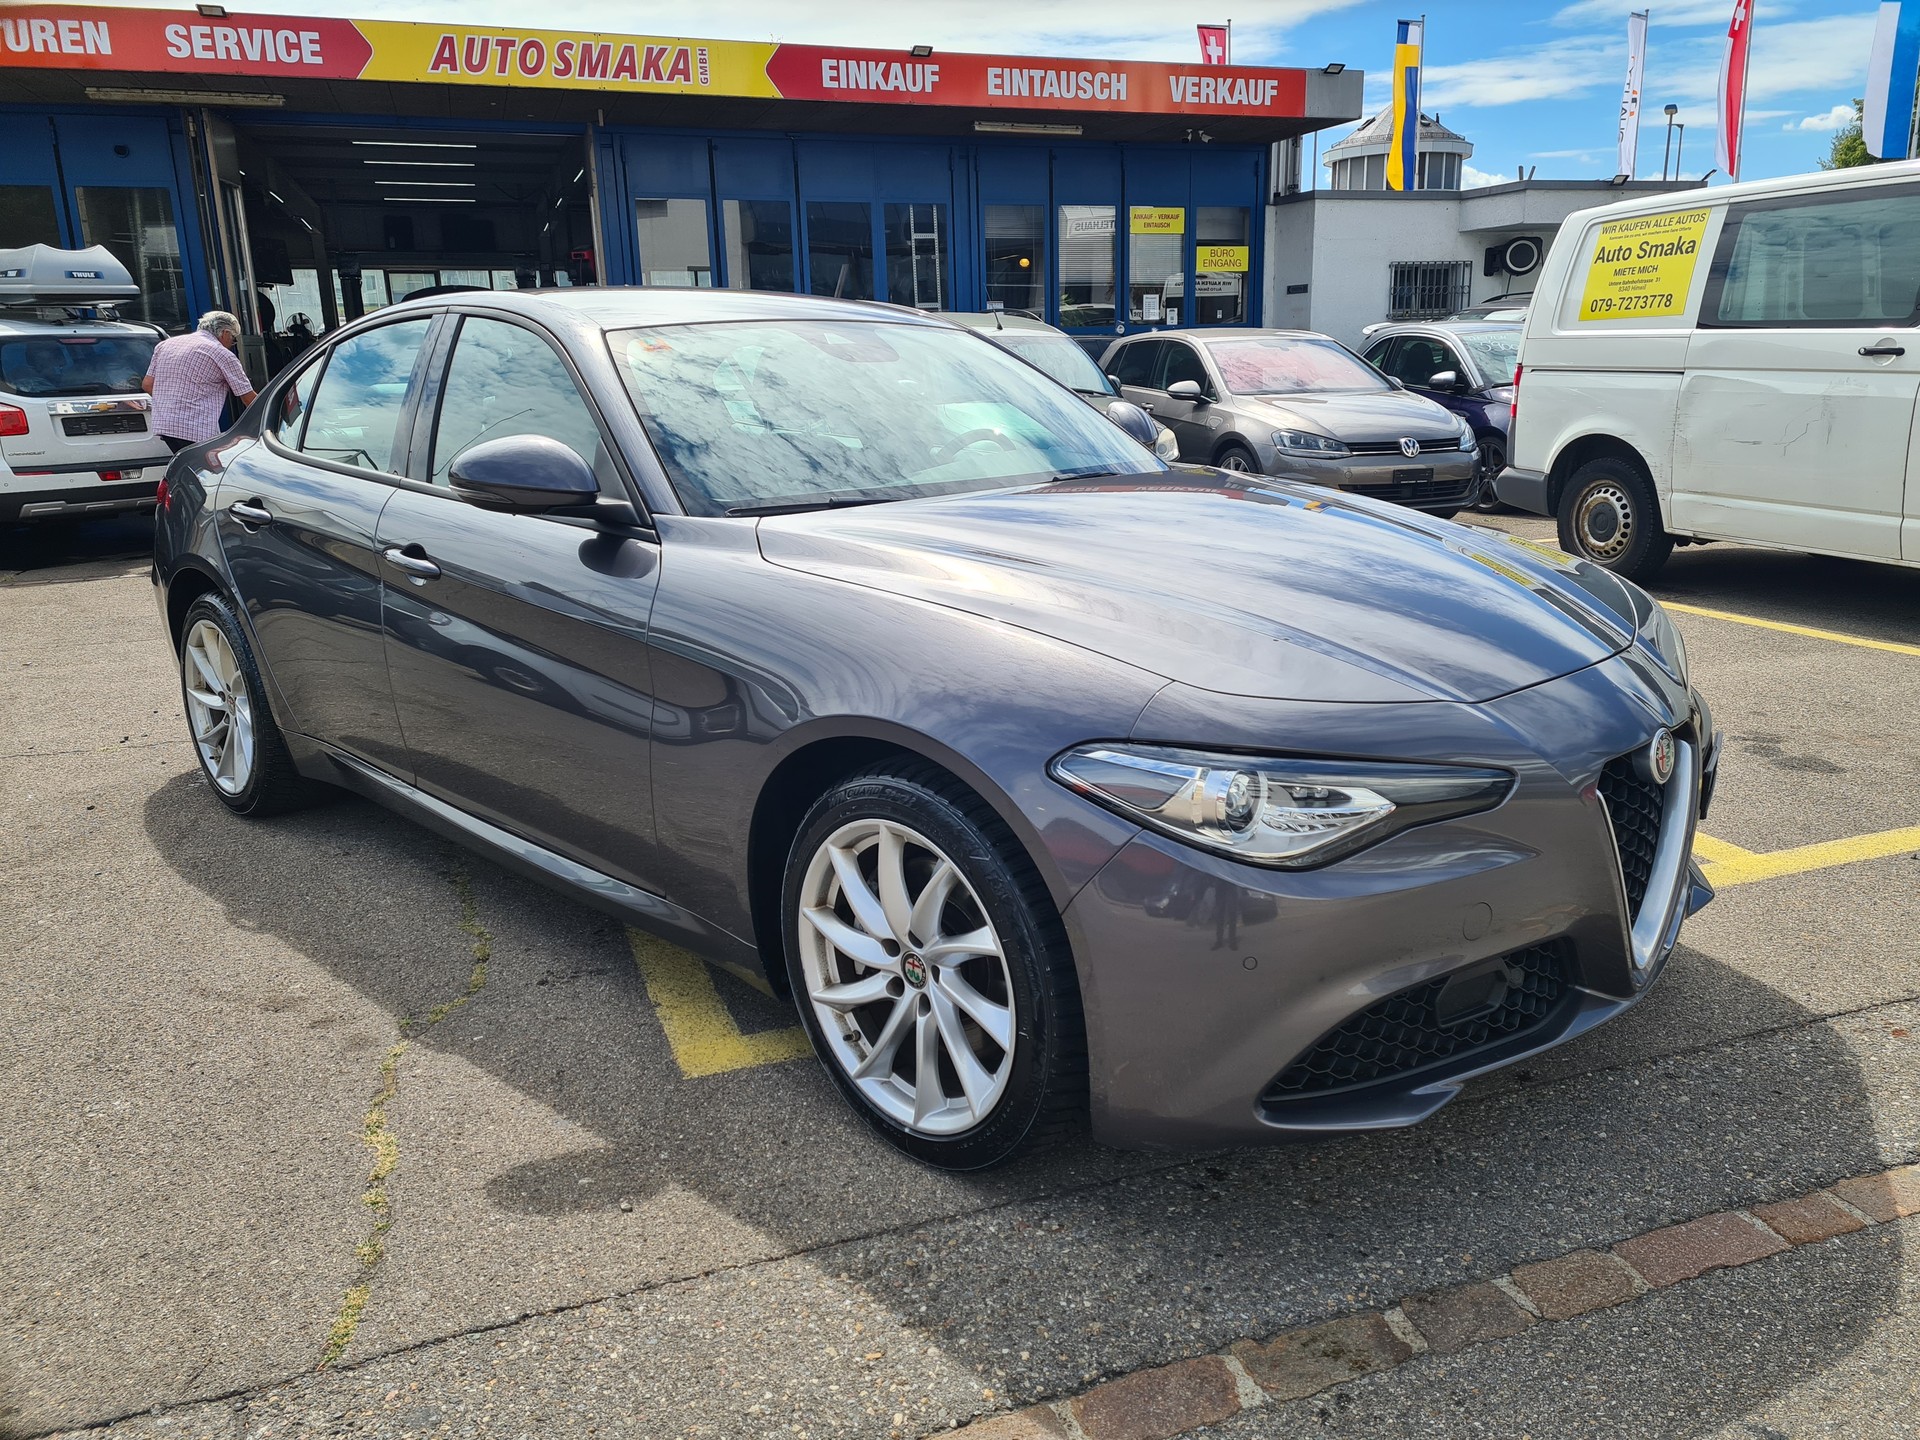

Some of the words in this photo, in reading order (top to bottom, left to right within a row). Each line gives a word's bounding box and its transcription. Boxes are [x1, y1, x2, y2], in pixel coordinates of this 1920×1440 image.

[0, 19, 112, 55] UREN
[165, 24, 323, 64] SERVICE
[428, 34, 547, 77] AUTO
[552, 39, 693, 83] SMAKA
[697, 48, 709, 84] GMBH
[821, 58, 940, 92] EINKAUF
[987, 67, 1127, 100] EINTAUSCH
[1169, 75, 1279, 105] VERKAUF
[1601, 225, 1617, 235] WIR
[1618, 220, 1651, 233] KAUFEN
[1652, 216, 1675, 228] ALLE
[1674, 212, 1707, 225] AUTOS
[1202, 258, 1242, 268] EINGANG
[1209, 247, 1235, 258] BÜRO
[1594, 245, 1632, 264] Auto
[1636, 236, 1697, 259] Smaka
[1613, 266, 1637, 277] MIETE
[1637, 264, 1659, 275] MICH
[1590, 293, 1673, 313] 079-7273778
